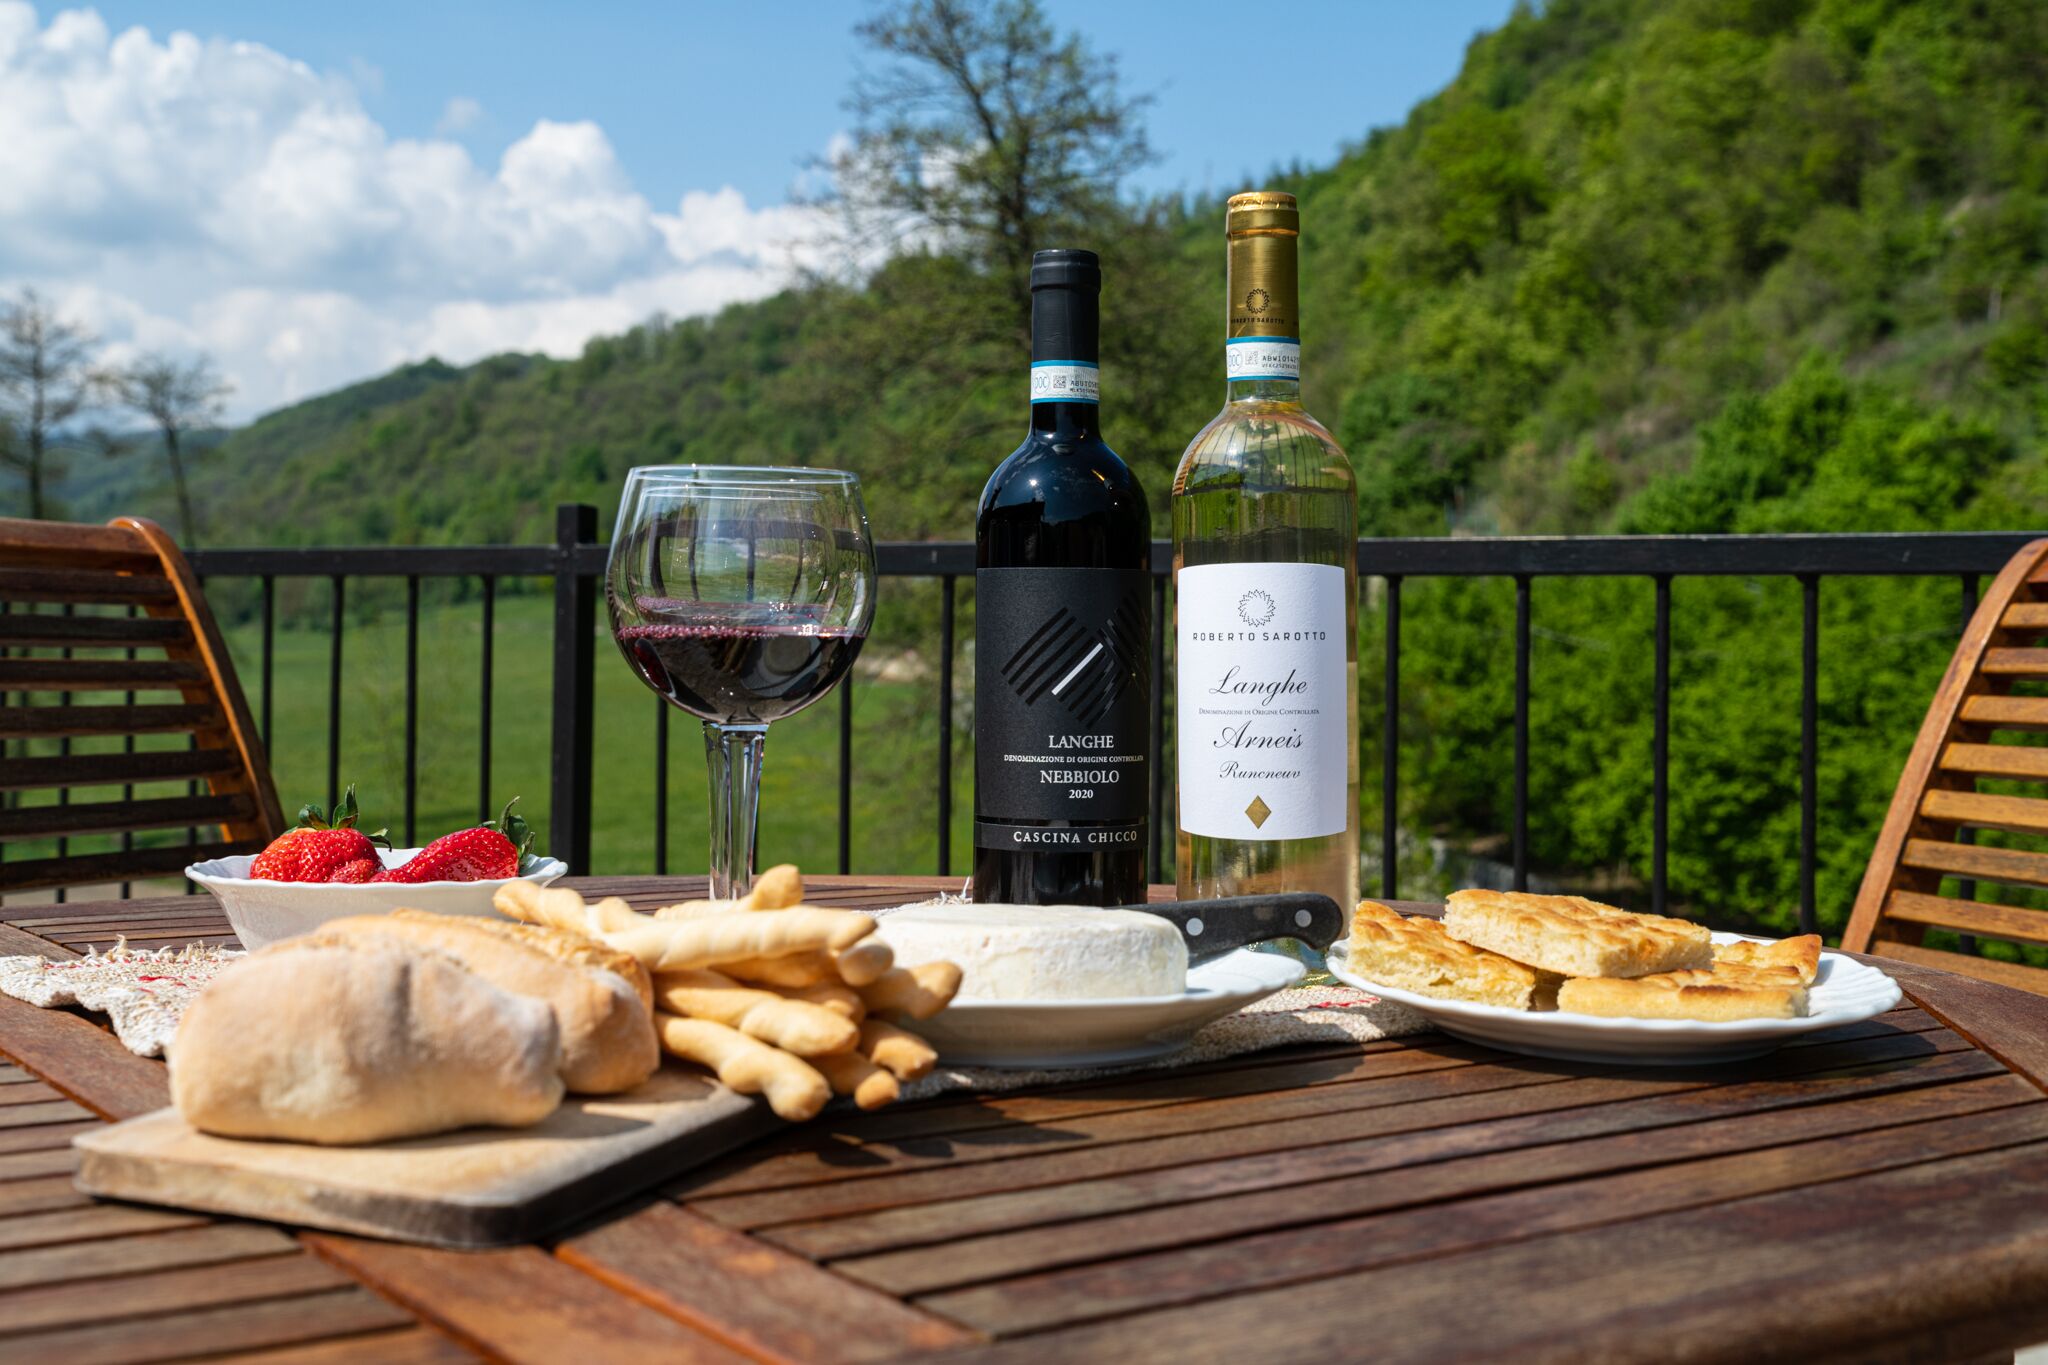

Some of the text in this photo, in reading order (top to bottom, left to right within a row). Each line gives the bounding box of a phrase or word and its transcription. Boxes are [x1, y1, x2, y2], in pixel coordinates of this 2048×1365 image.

[1192, 631, 1326, 641] ROBERTO SAROTTO
[1208, 665, 1308, 707] Langhe
[1213, 720, 1304, 749] Arneis
[1048, 735, 1115, 749] LANGHE
[1003, 754, 1065, 763] DENOMINAZIONE
[1040, 770, 1120, 784] NEBBIOLO
[1068, 789, 1094, 799] 2020
[1013, 831, 1138, 843] CASCINA CHICCO
